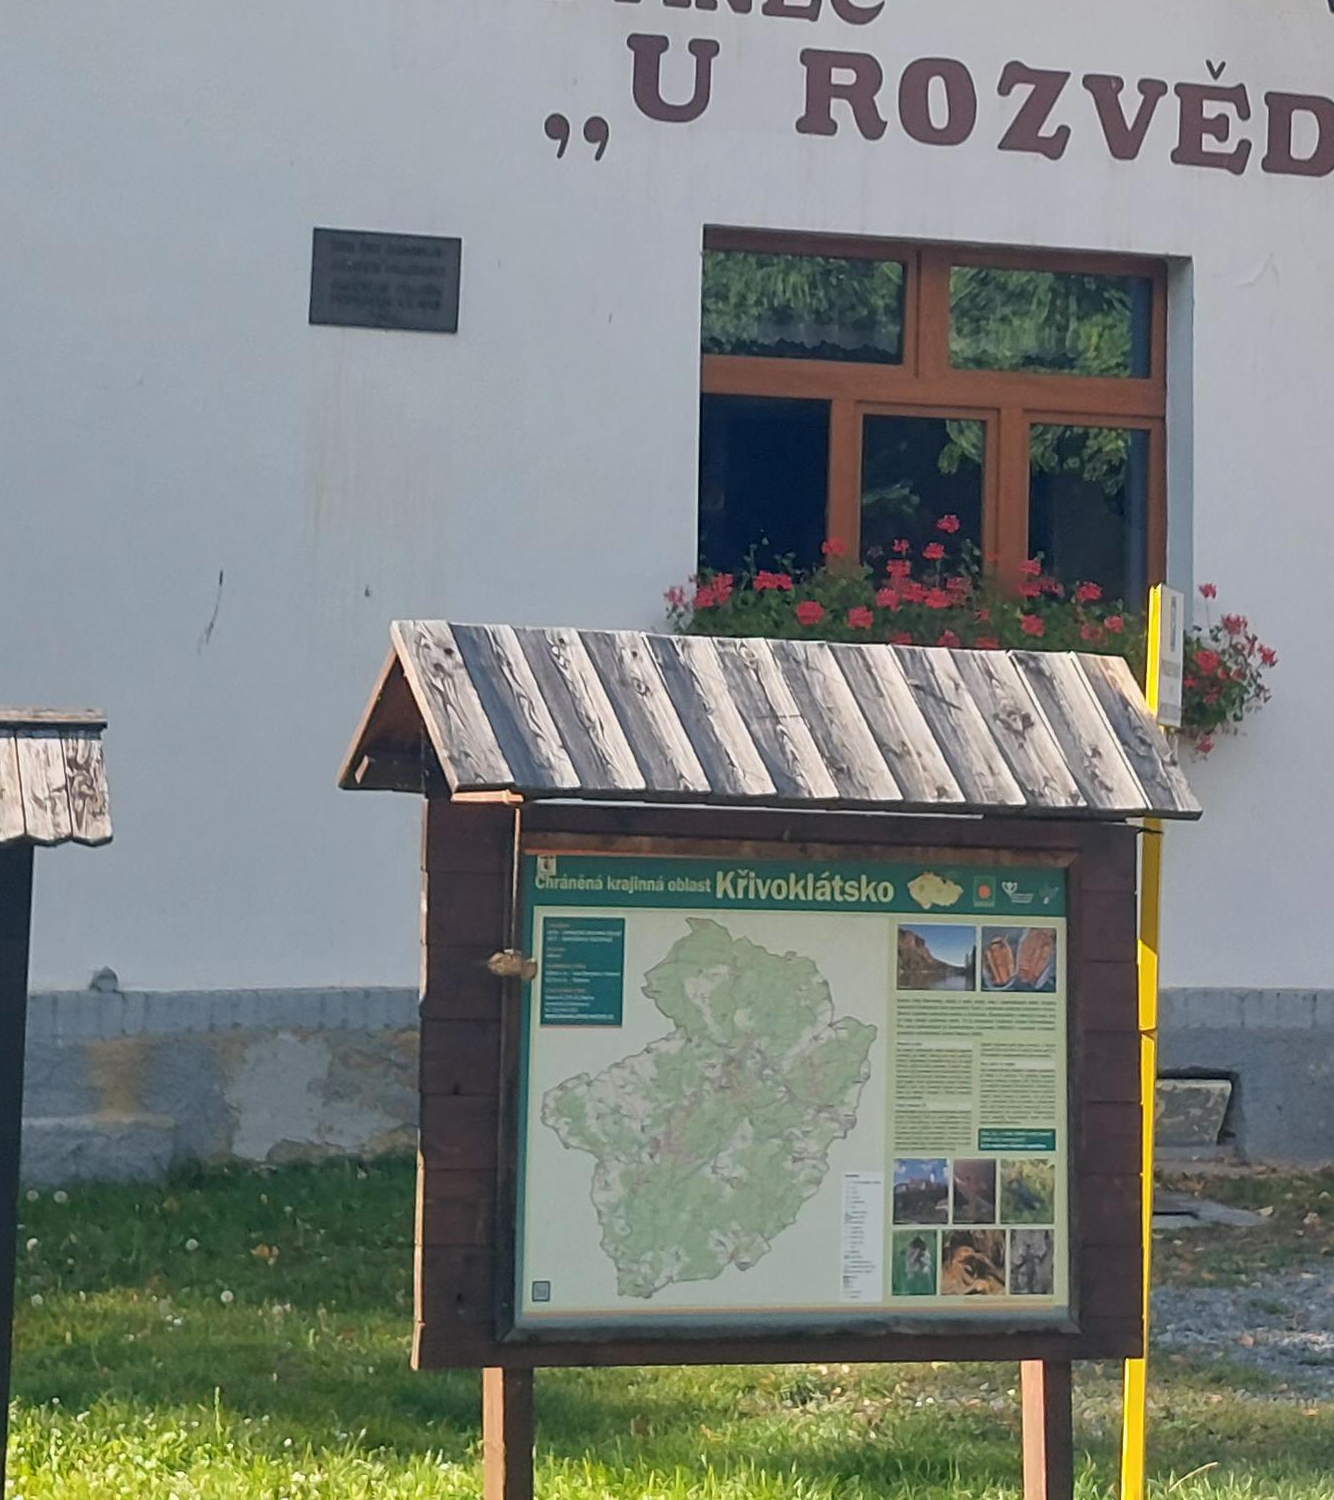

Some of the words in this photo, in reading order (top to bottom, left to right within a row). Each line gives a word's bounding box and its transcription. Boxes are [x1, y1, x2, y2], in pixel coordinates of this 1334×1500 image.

[535, 874, 603, 890] Chráněná
[607, 875, 664, 894] krajinná
[668, 879, 711, 893] oblast
[716, 868, 895, 903] Křivoklátsko
